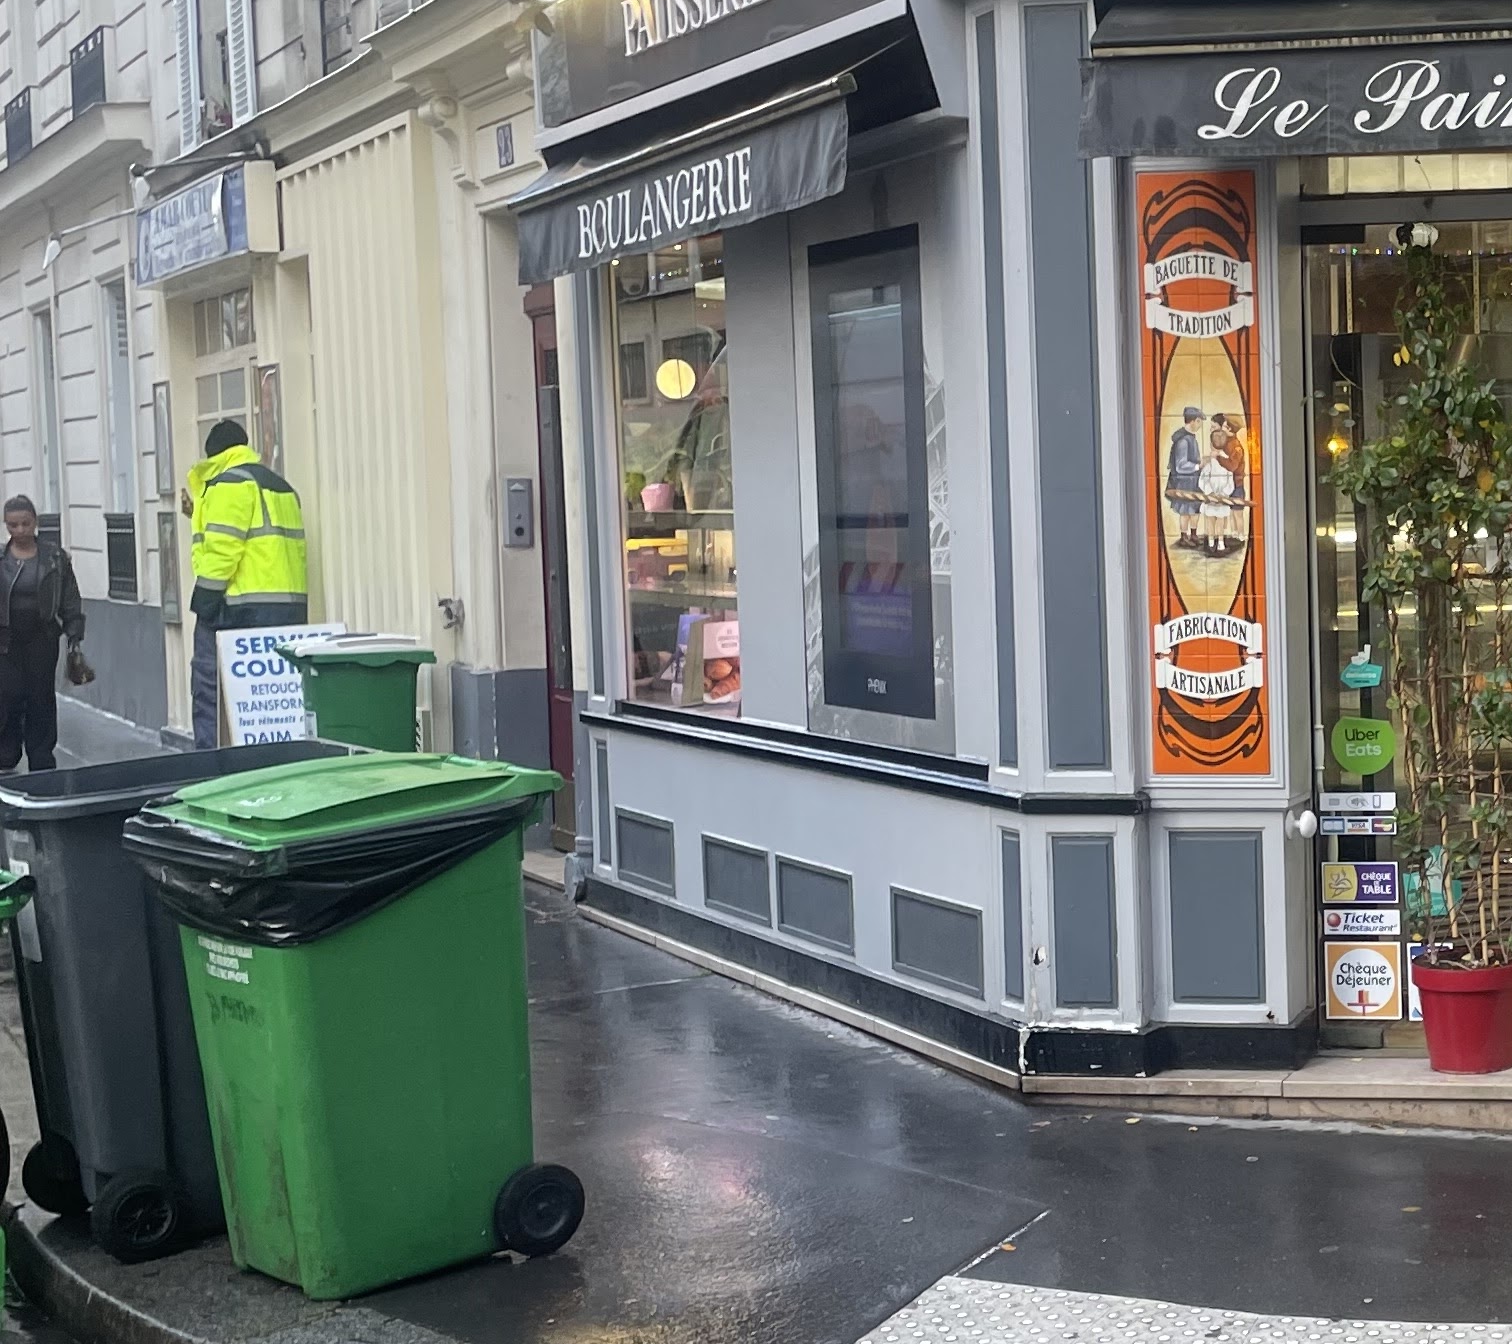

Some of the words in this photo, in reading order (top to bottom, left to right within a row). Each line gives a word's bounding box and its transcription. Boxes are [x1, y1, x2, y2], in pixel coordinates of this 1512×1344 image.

[1198, 66, 1329, 141] Le
[577, 146, 752, 258] BOULANGERIE
[1155, 254, 1216, 285] BAGUETTE
[1223, 259, 1239, 282] DE
[1168, 311, 1232, 336] TRADITION
[1168, 616, 1248, 644] FABRICATION
[1170, 669, 1246, 696] ARTISANALE
[1344, 728, 1381, 742] Uber
[1345, 743, 1382, 757] Eats
[1361, 885, 1393, 895] TABLE
[1342, 912, 1385, 924] Ticket
[1339, 961, 1388, 976] Chèque
[1336, 974, 1392, 989] Déjeuner
